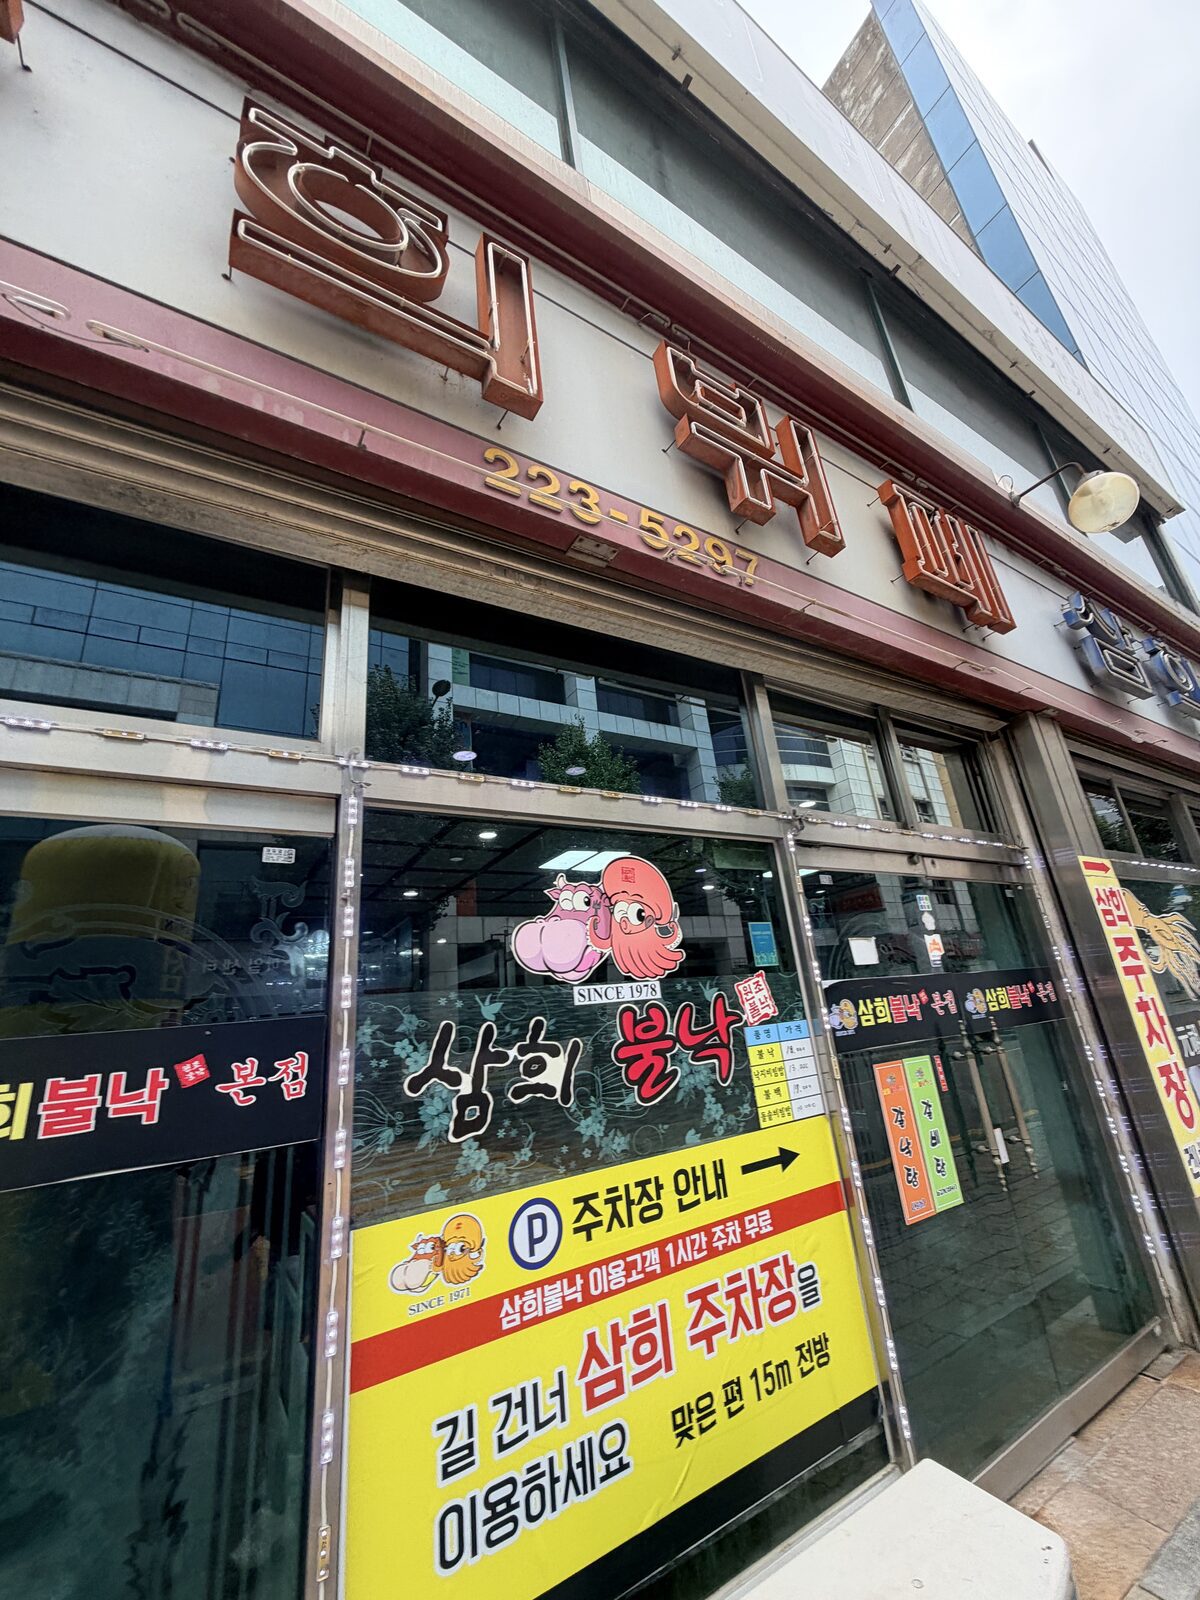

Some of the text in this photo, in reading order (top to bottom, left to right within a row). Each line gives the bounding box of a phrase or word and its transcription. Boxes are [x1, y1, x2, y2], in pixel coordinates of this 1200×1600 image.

[483, 447, 760, 587] 223-5297
[577, 983, 658, 1003] SINCE 1978
[1112, 936, 1195, 1130] 주차장
[215, 1051, 310, 1107] 본점
[404, 991, 746, 1144] 삼희 불낙
[572, 1179, 664, 1242] 주차장
[673, 1158, 729, 1213] 안내
[408, 1287, 471, 1316] SINCE 1971
[500, 1209, 774, 1331] 삼희불낙 이용고객 1시간 주차 무료
[435, 1251, 821, 1485] 길 건너 삼희 주차장을
[671, 1333, 832, 1449] 맞은 편 15m 전방
[437, 1421, 632, 1572] 이용하세요
